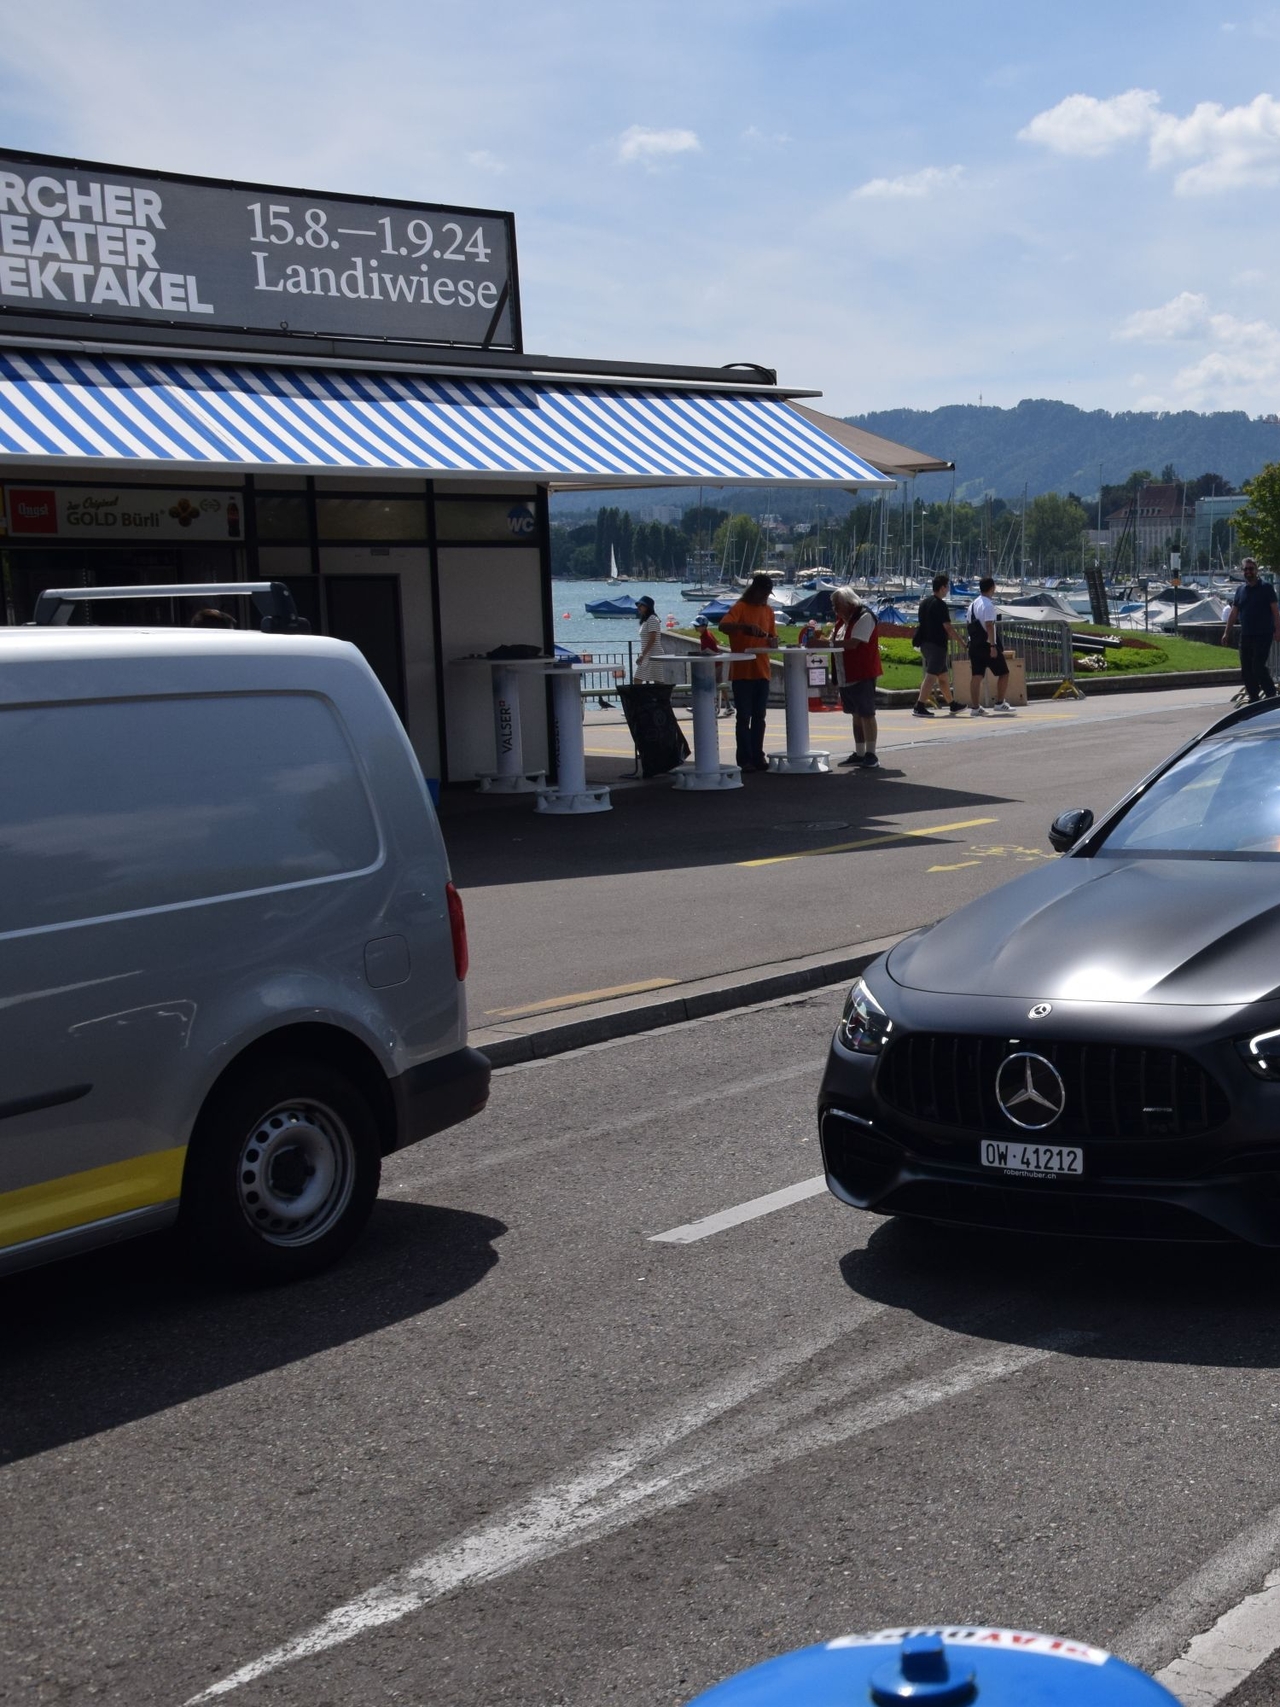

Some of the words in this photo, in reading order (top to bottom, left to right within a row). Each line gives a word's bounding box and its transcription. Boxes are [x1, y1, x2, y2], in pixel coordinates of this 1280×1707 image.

[0, 170, 166, 230] RCHER
[0, 214, 160, 268] EATER
[0, 255, 214, 314] EKTAKEL
[251, 251, 498, 309] Landiwiese
[67, 511, 117, 526] GOLD
[506, 517, 535, 533] WC
[500, 706, 512, 755] VALSER
[1003, 1169, 1057, 1180] roberthuber.ch
